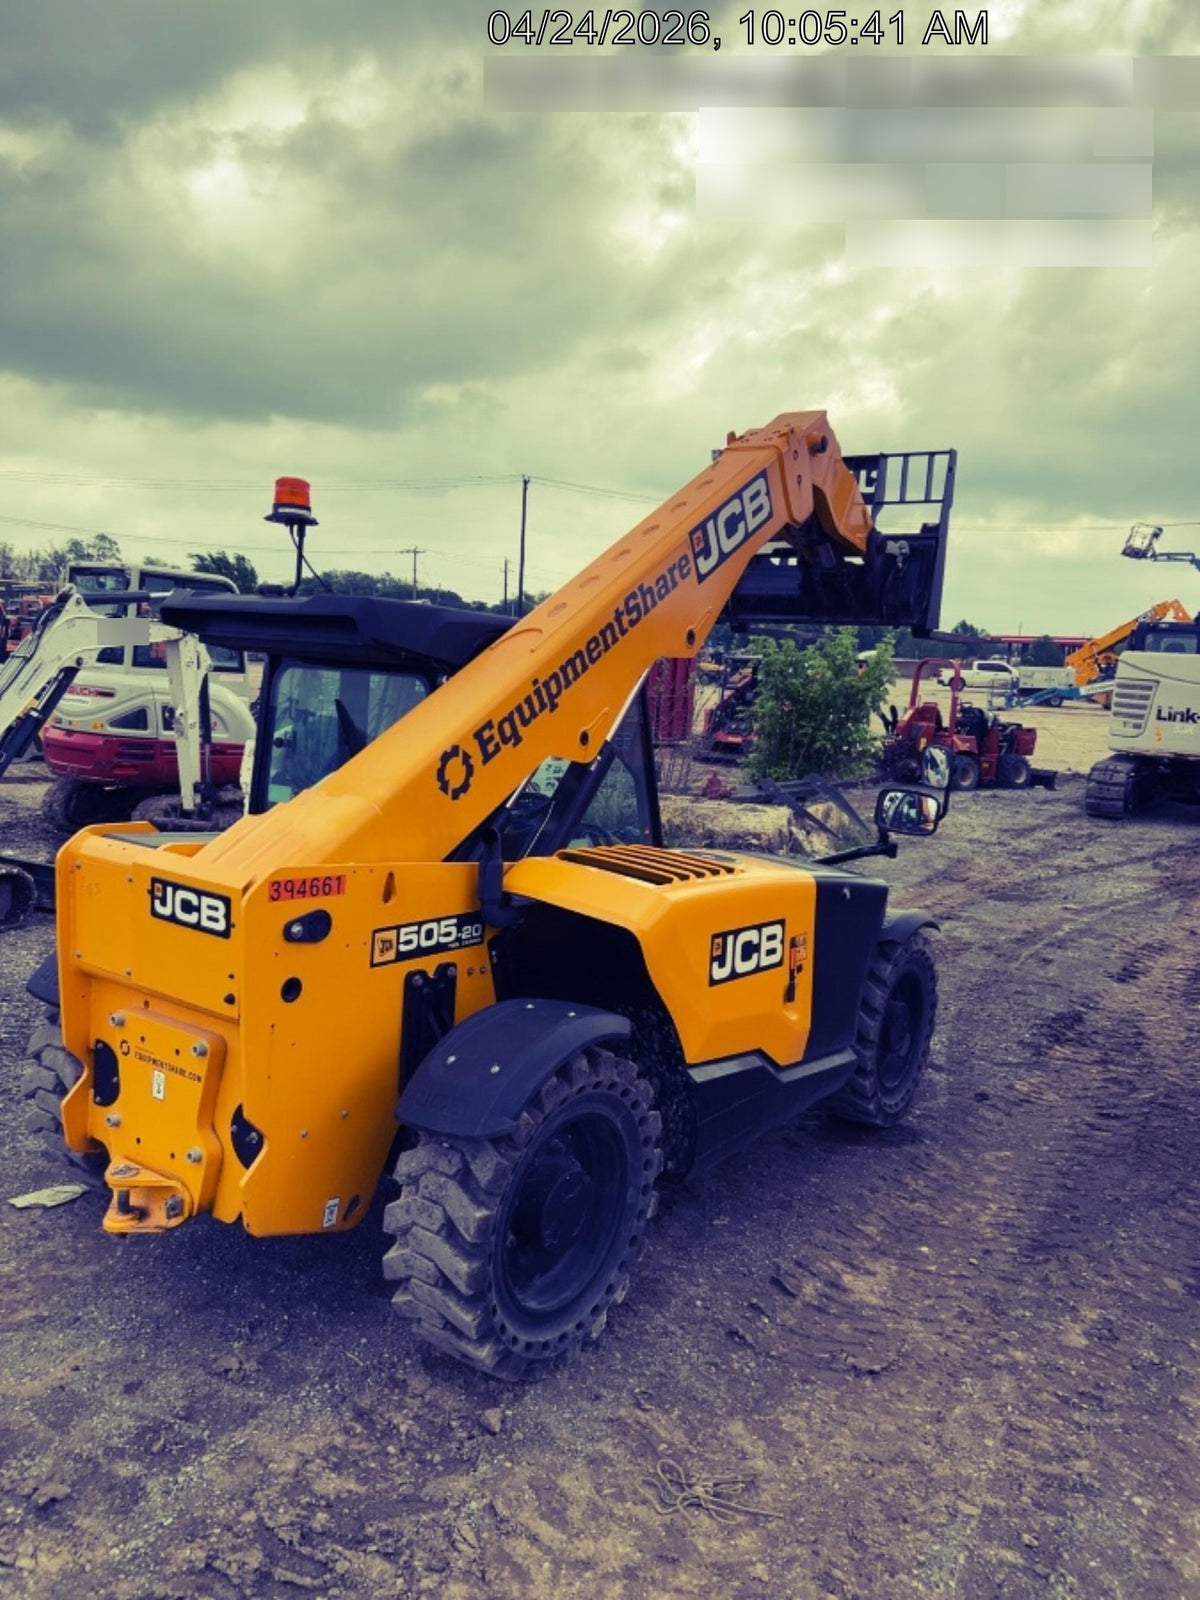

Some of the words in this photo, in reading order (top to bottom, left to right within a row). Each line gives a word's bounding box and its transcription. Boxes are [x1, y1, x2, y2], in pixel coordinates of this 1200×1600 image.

[695, 476, 771, 576] JCB
[472, 553, 691, 766] EquipmentShare
[154, 886, 227, 931] JCB
[269, 876, 343, 901] 394661
[712, 924, 783, 980] JCB
